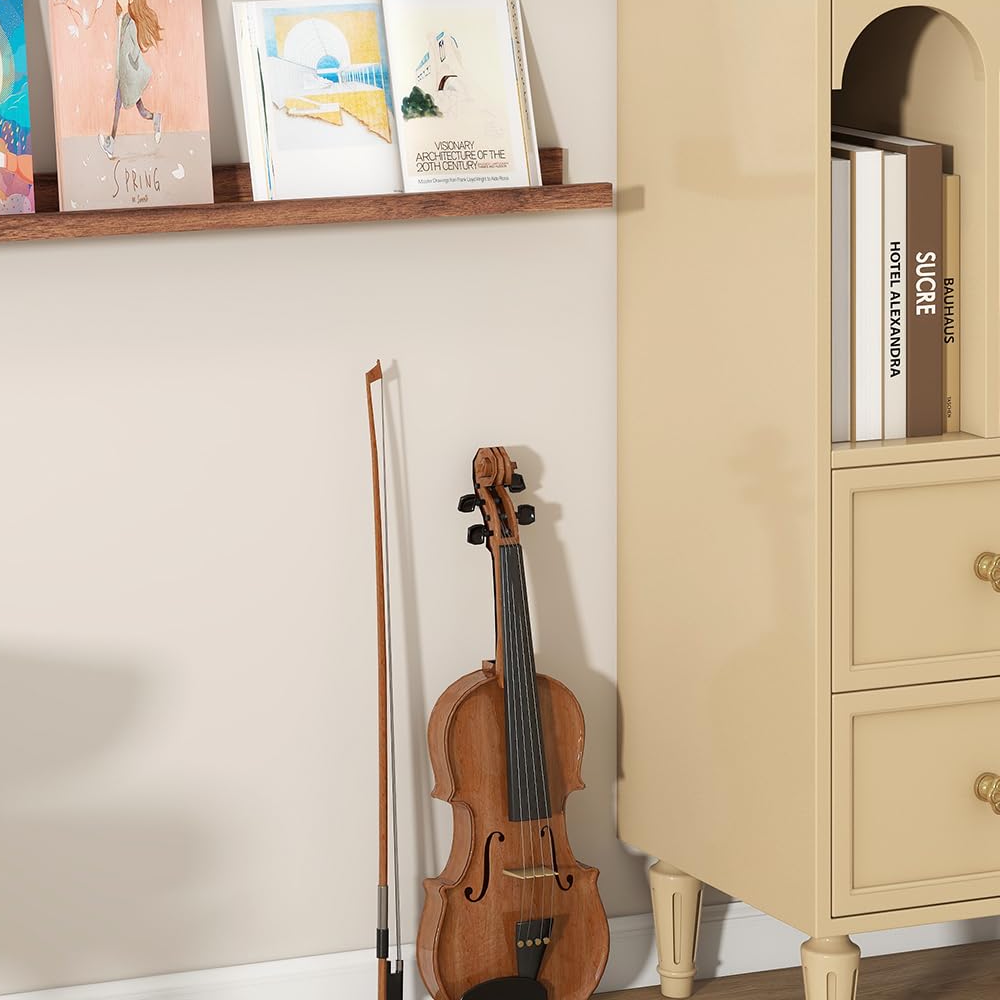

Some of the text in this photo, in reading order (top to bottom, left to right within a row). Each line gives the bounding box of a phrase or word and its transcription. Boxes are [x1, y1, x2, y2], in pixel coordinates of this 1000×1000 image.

[415, 149, 506, 162] ARCHITECTURE OF THE
[434, 140, 475, 151] VISIONARY
[112, 159, 161, 198] SPRING
[416, 161, 441, 173] 20TH
[442, 160, 478, 171] CENTURY
[915, 251, 936, 316] SUCRE
[890, 241, 901, 378] HOTEL ALEXANDRA
[943, 277, 955, 344] BAUHAUS
